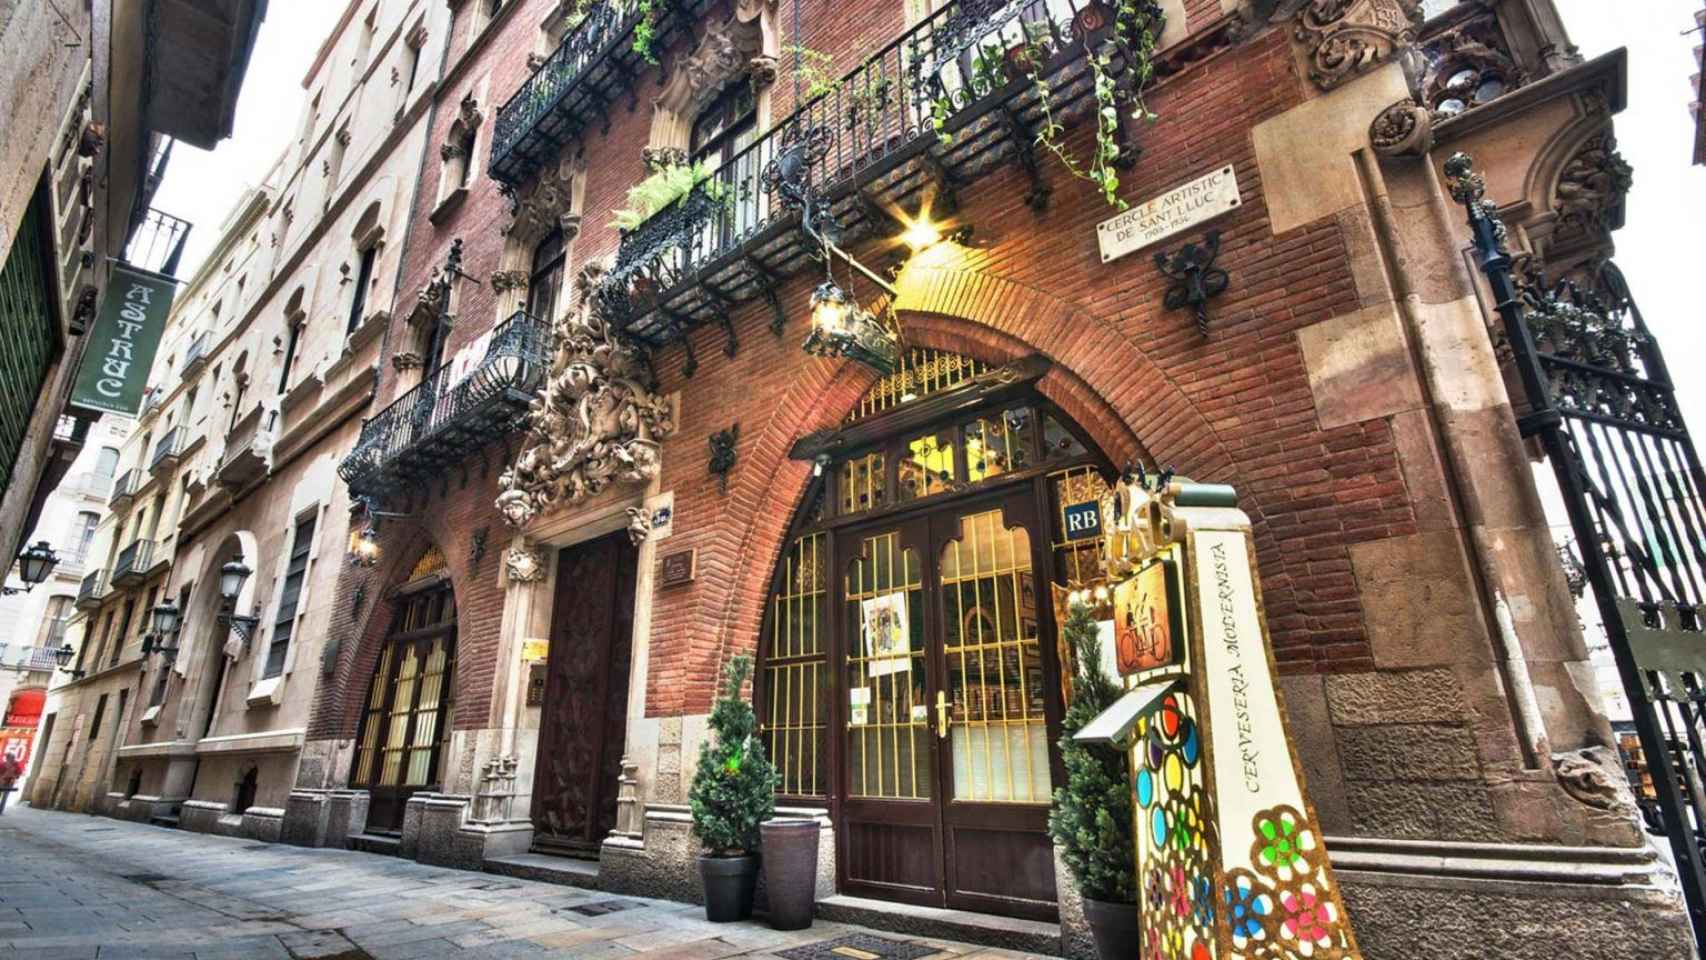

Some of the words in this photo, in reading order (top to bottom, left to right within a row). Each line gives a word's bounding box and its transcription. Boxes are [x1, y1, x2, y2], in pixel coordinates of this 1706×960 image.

[1106, 201, 1158, 232] CERCLE
[1161, 174, 1222, 209] ARTISTIC
[1116, 228, 1135, 242] DE
[1139, 210, 1172, 233] SANT
[1177, 192, 1214, 215] LLUC
[96, 283, 154, 397] ASTRUC
[1068, 510, 1098, 532] RB
[1210, 542, 1241, 658] MODERNISTA
[1228, 664, 1260, 793] CERVESERIA
